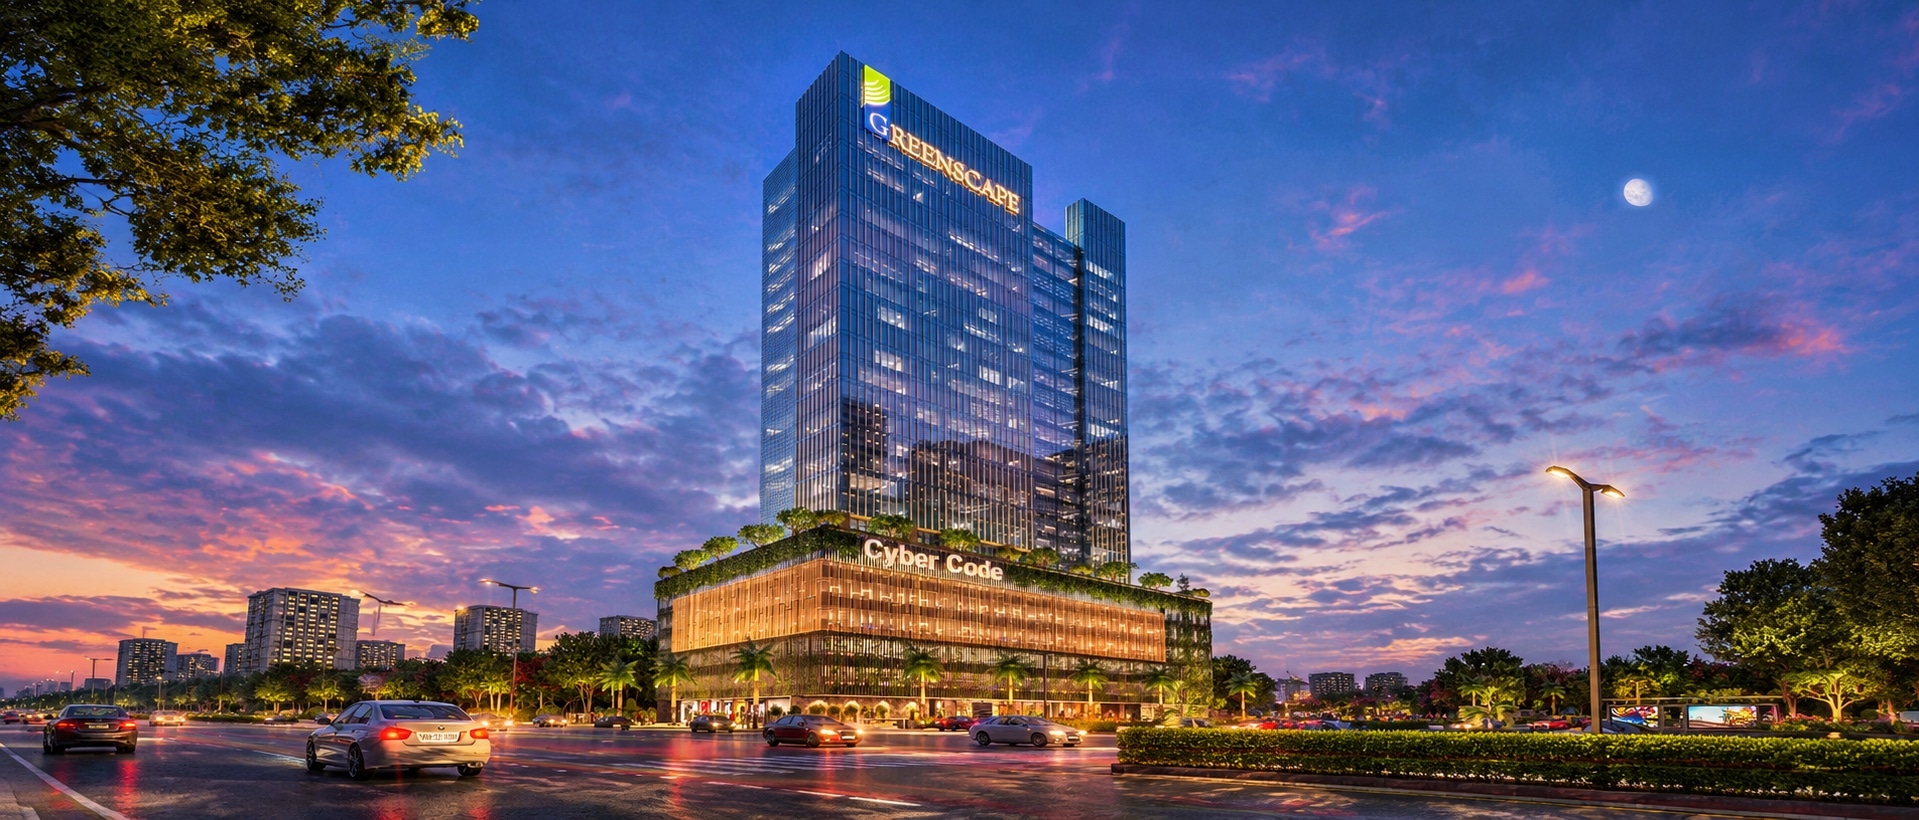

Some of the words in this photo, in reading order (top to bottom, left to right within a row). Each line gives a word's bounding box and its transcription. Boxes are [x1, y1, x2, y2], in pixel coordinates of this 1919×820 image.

[869, 112, 1020, 214] GREENSCAPE
[864, 538, 939, 570] Cyber
[946, 554, 1003, 580] Code
